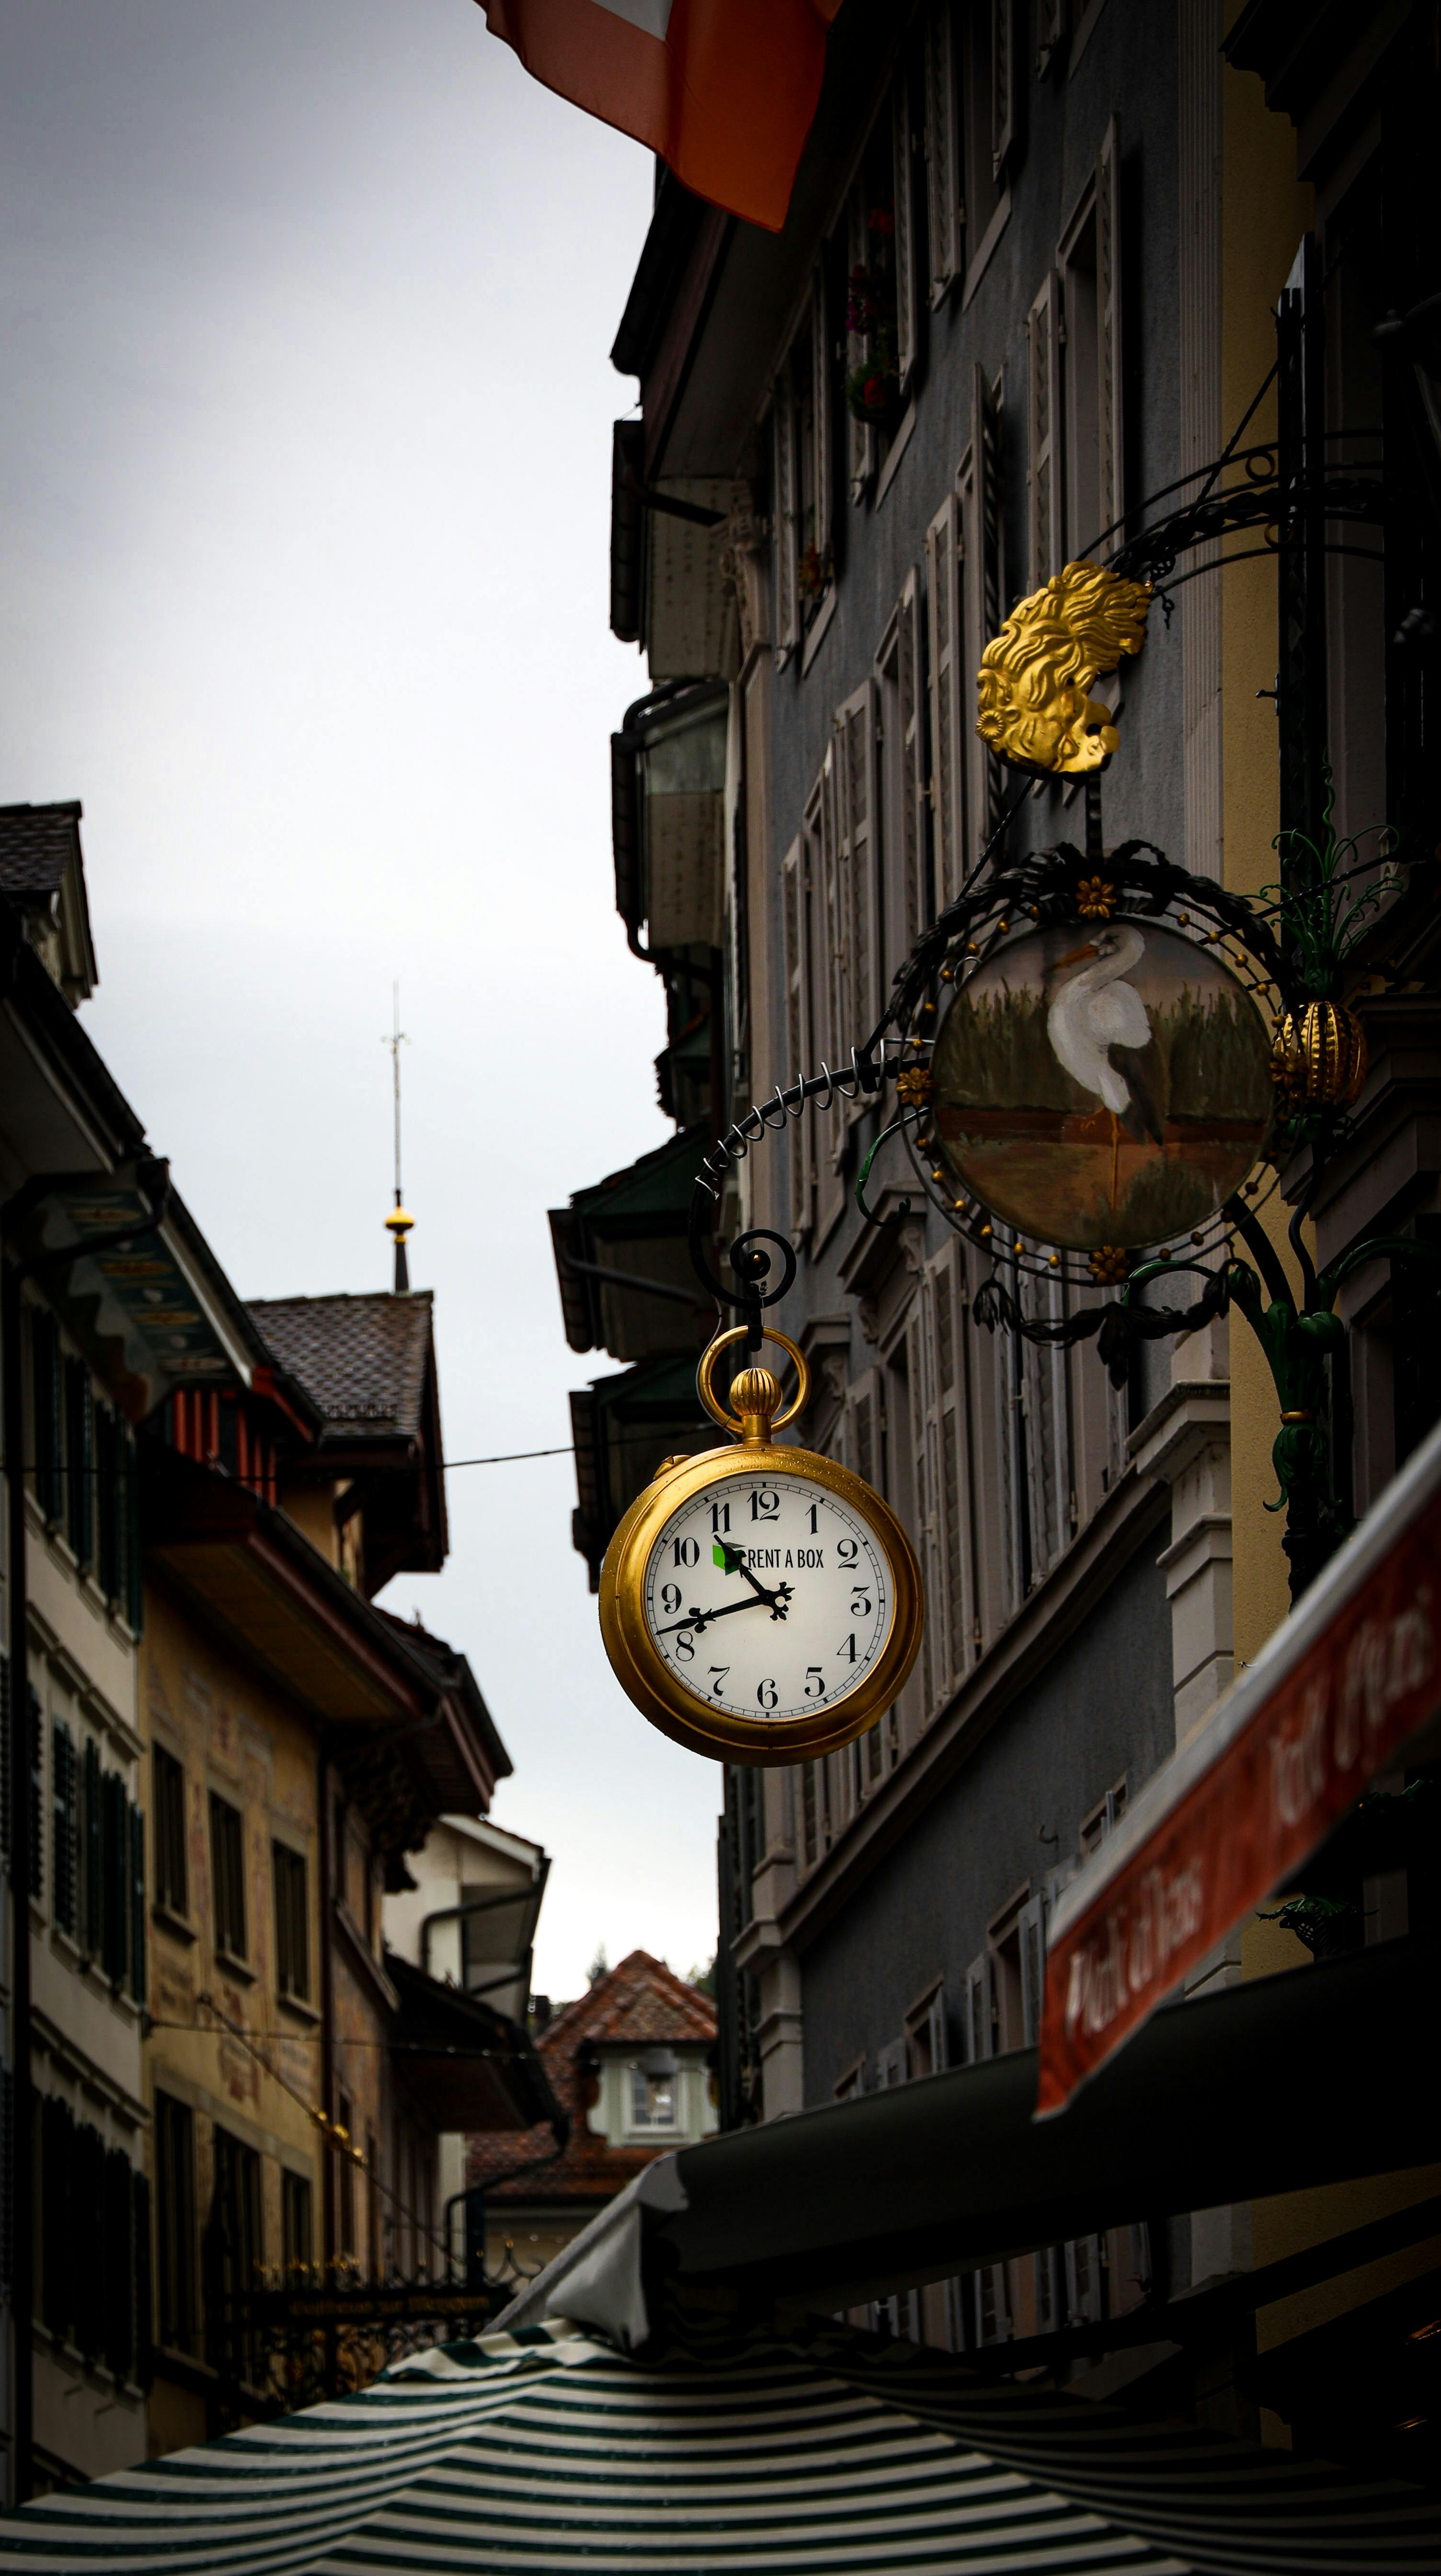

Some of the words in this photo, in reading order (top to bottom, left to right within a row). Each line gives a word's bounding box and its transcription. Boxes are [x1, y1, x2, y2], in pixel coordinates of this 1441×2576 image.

[705, 1503, 731, 1533] 11
[747, 1490, 781, 1521] 12
[806, 1504, 818, 1534] 1
[669, 1536, 700, 1567] 10
[748, 1549, 781, 1568] RENT
[785, 1549, 794, 1568] A
[797, 1549, 824, 1568] BOX
[837, 1539, 859, 1569] 2
[662, 1584, 681, 1614] 9
[851, 1587, 871, 1616] 3
[676, 1631, 695, 1661] 8
[837, 1634, 861, 1663] 4
[708, 1667, 730, 1696] 7
[758, 1679, 778, 1709] 6
[805, 1668, 825, 1696] 5
